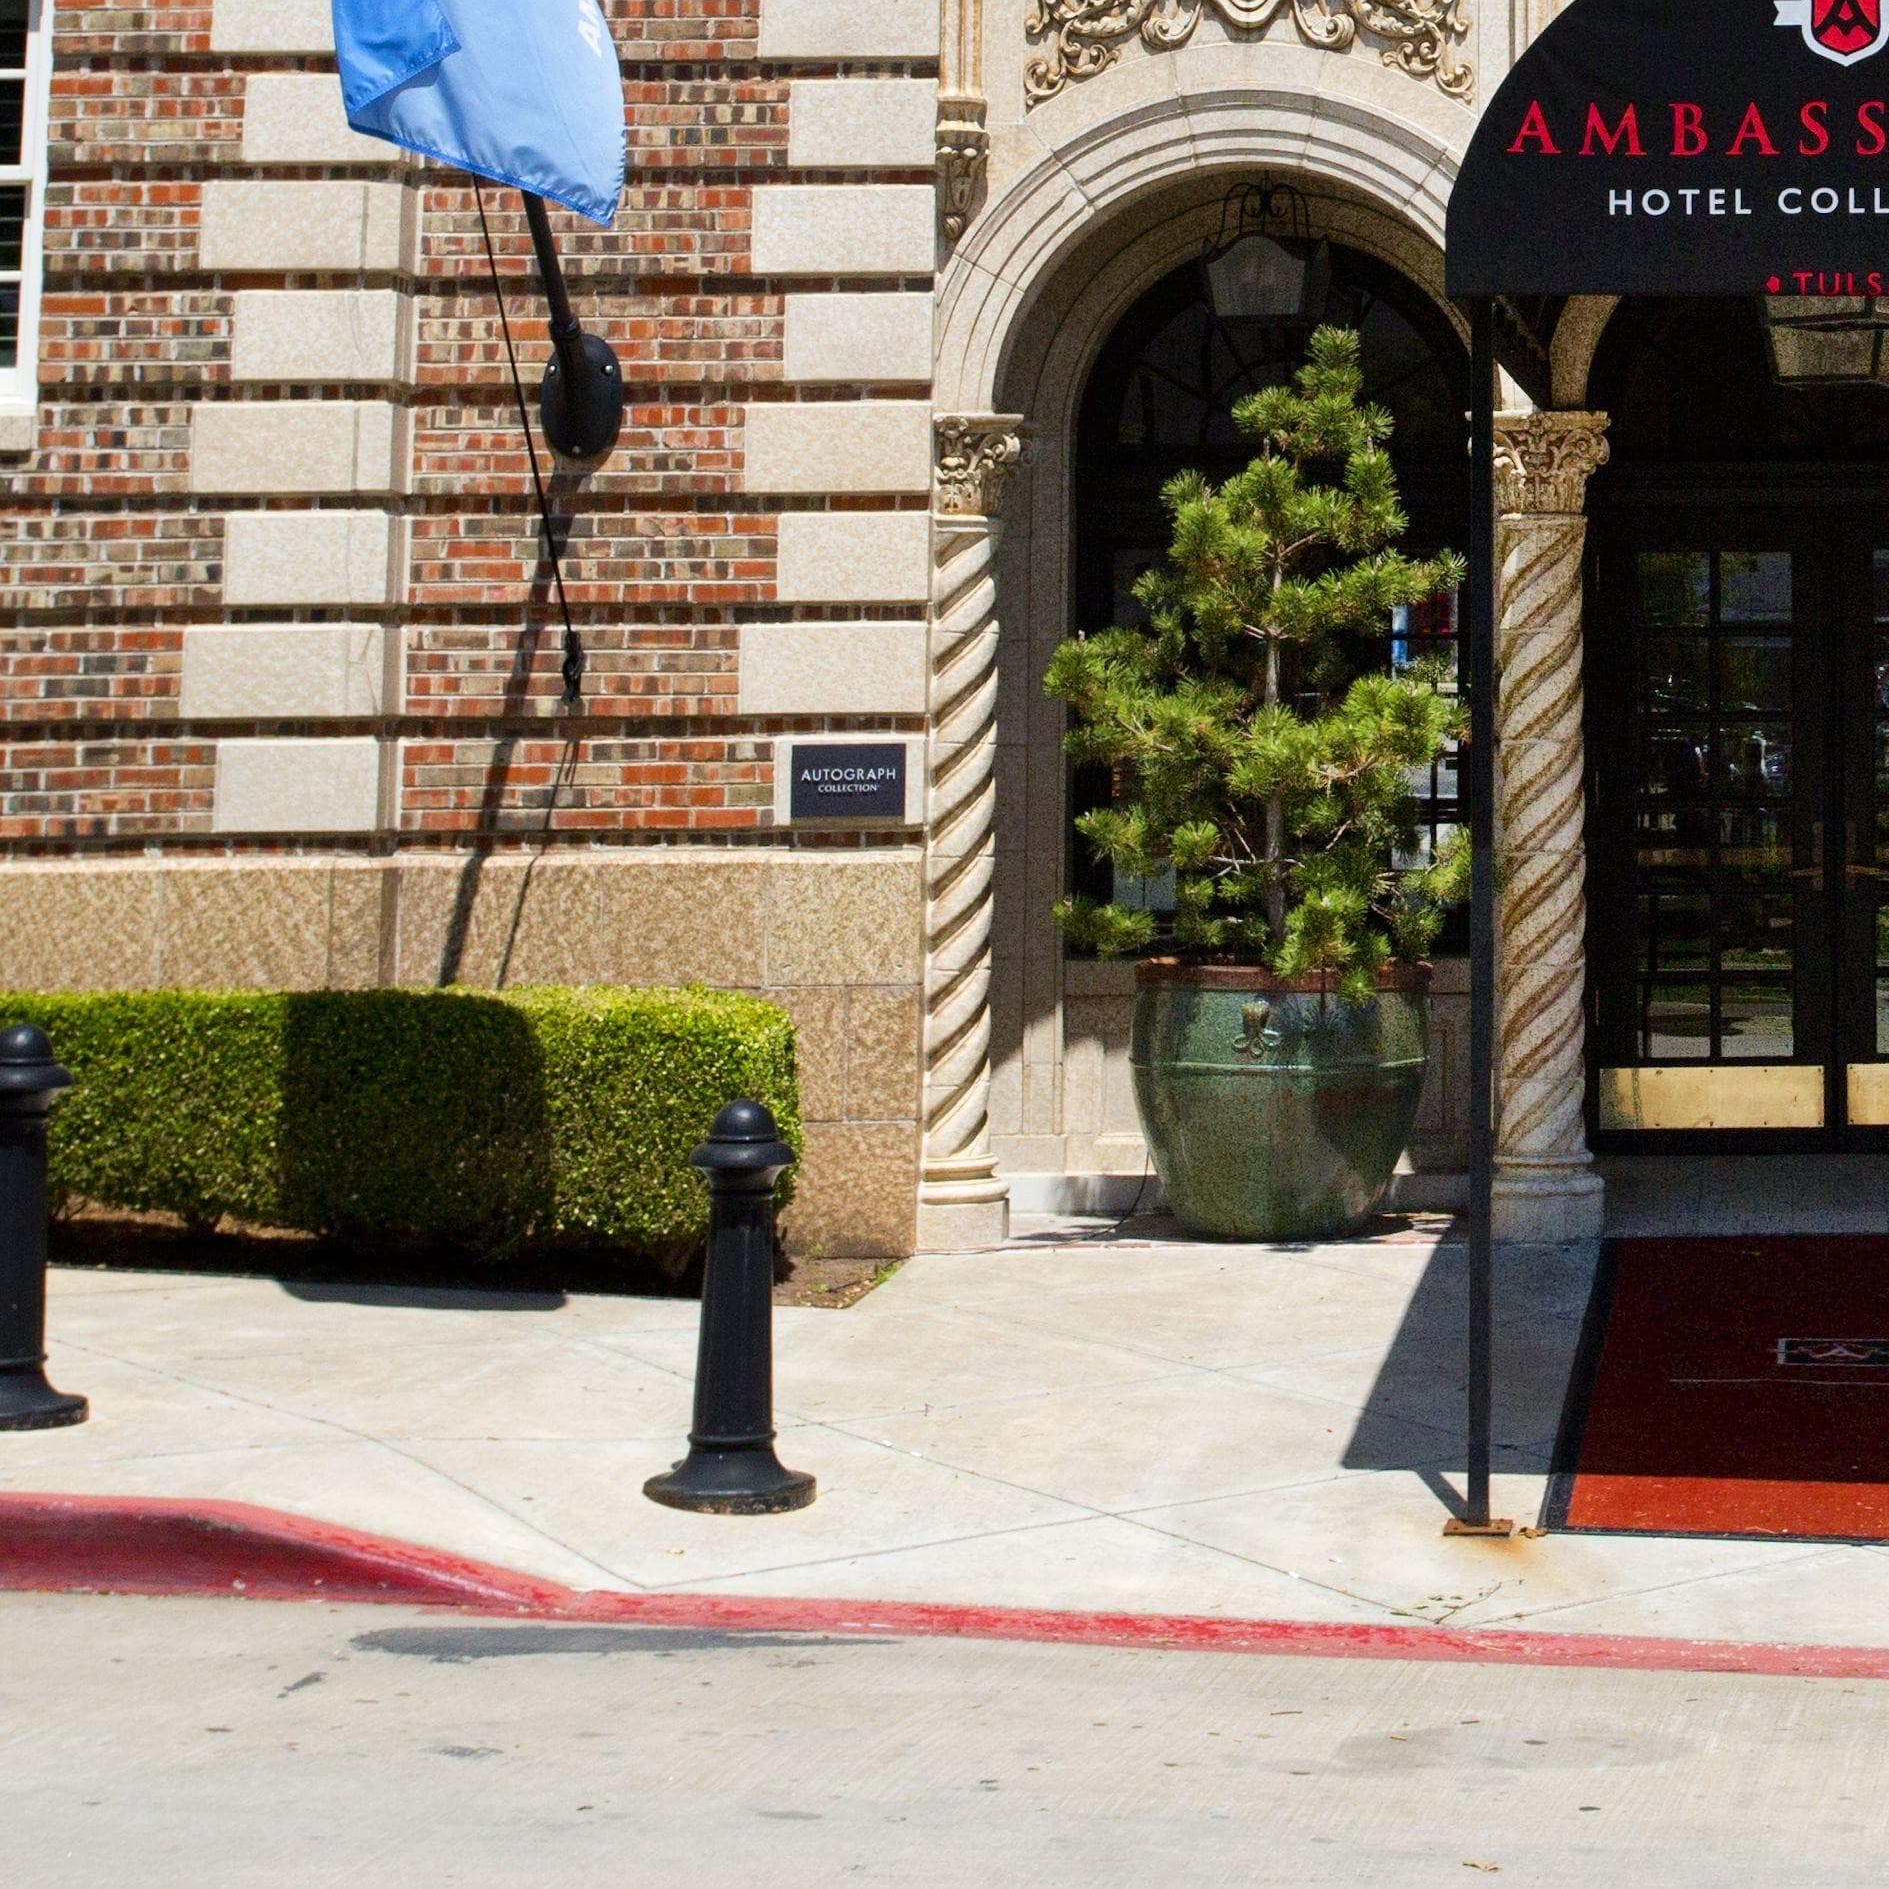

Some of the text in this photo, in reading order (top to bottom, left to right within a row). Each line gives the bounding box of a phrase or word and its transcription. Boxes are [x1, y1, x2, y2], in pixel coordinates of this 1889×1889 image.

[1609, 188, 1752, 216] HOTEL
[801, 768, 896, 781] AUTOGRAPH
[817, 783, 878, 793] COLLECTION
